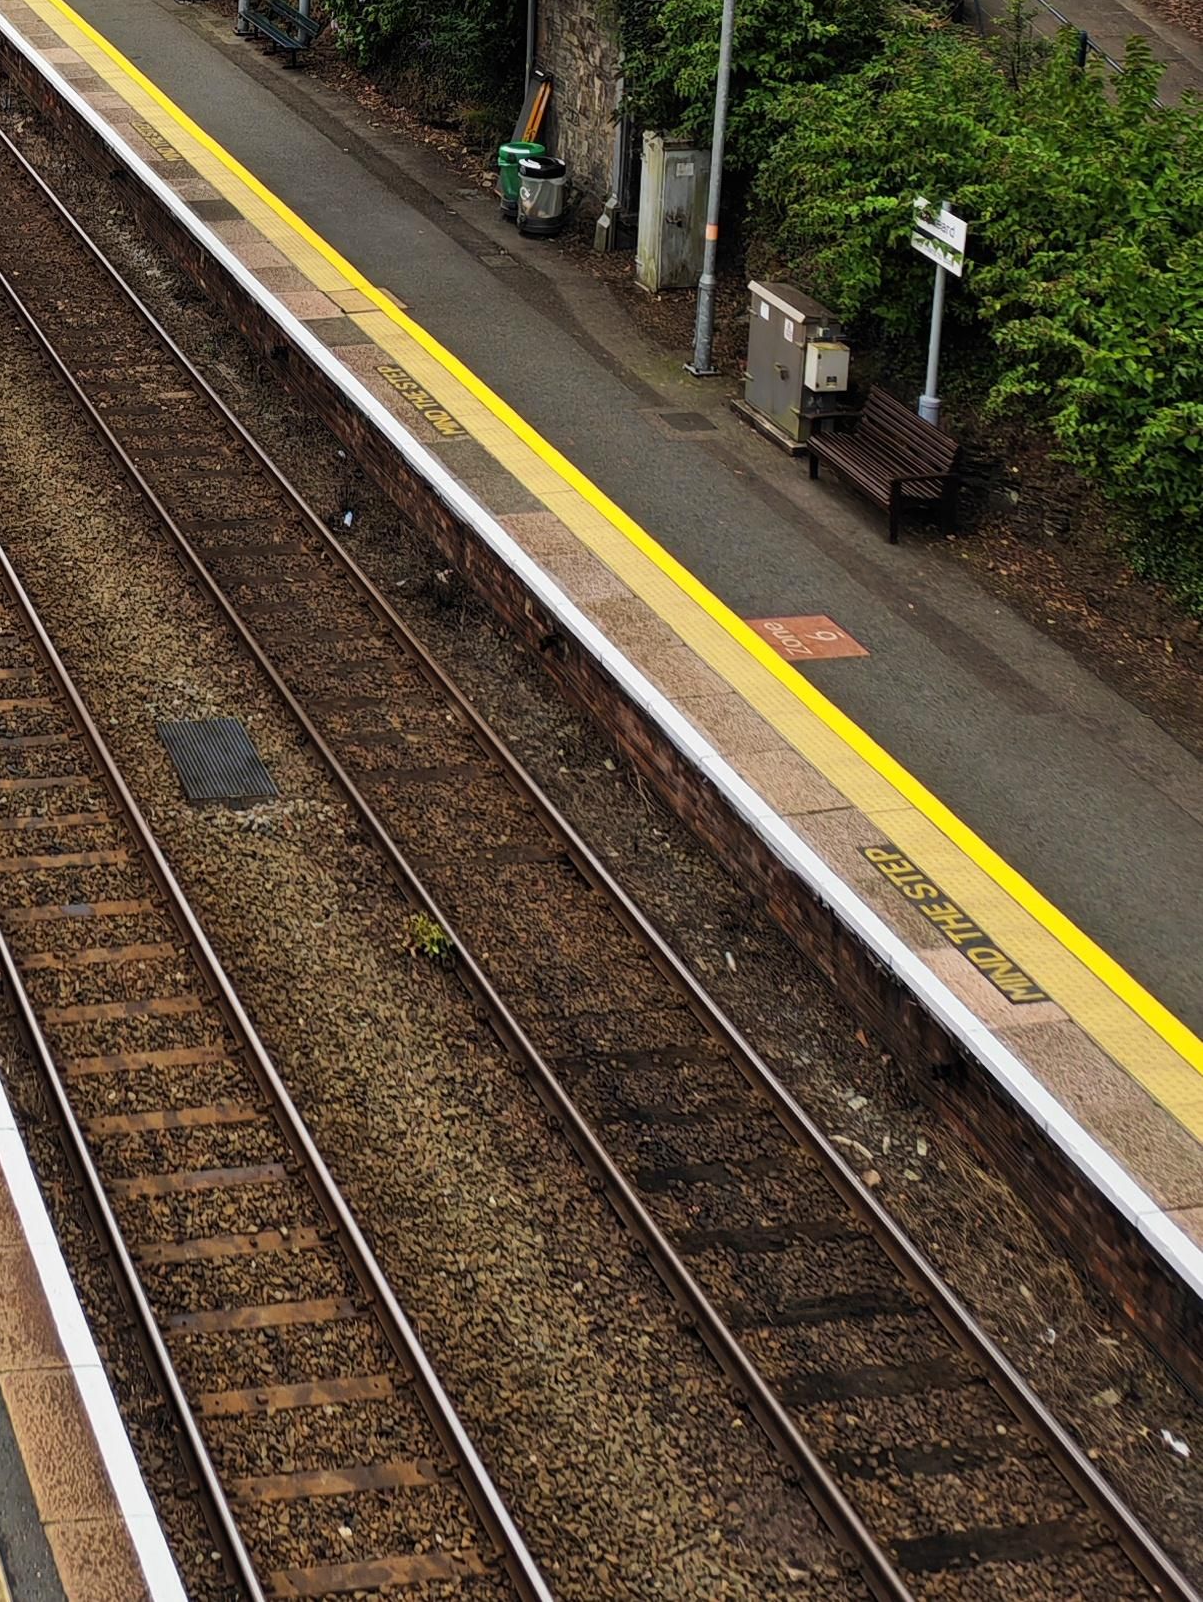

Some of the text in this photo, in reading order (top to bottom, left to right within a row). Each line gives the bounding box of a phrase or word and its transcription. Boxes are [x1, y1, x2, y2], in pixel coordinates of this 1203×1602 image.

[377, 365, 466, 435] MIND THE STEP
[763, 621, 814, 656] Zone
[804, 630, 839, 642] 6
[864, 847, 1046, 1002] MIND THE STEP
